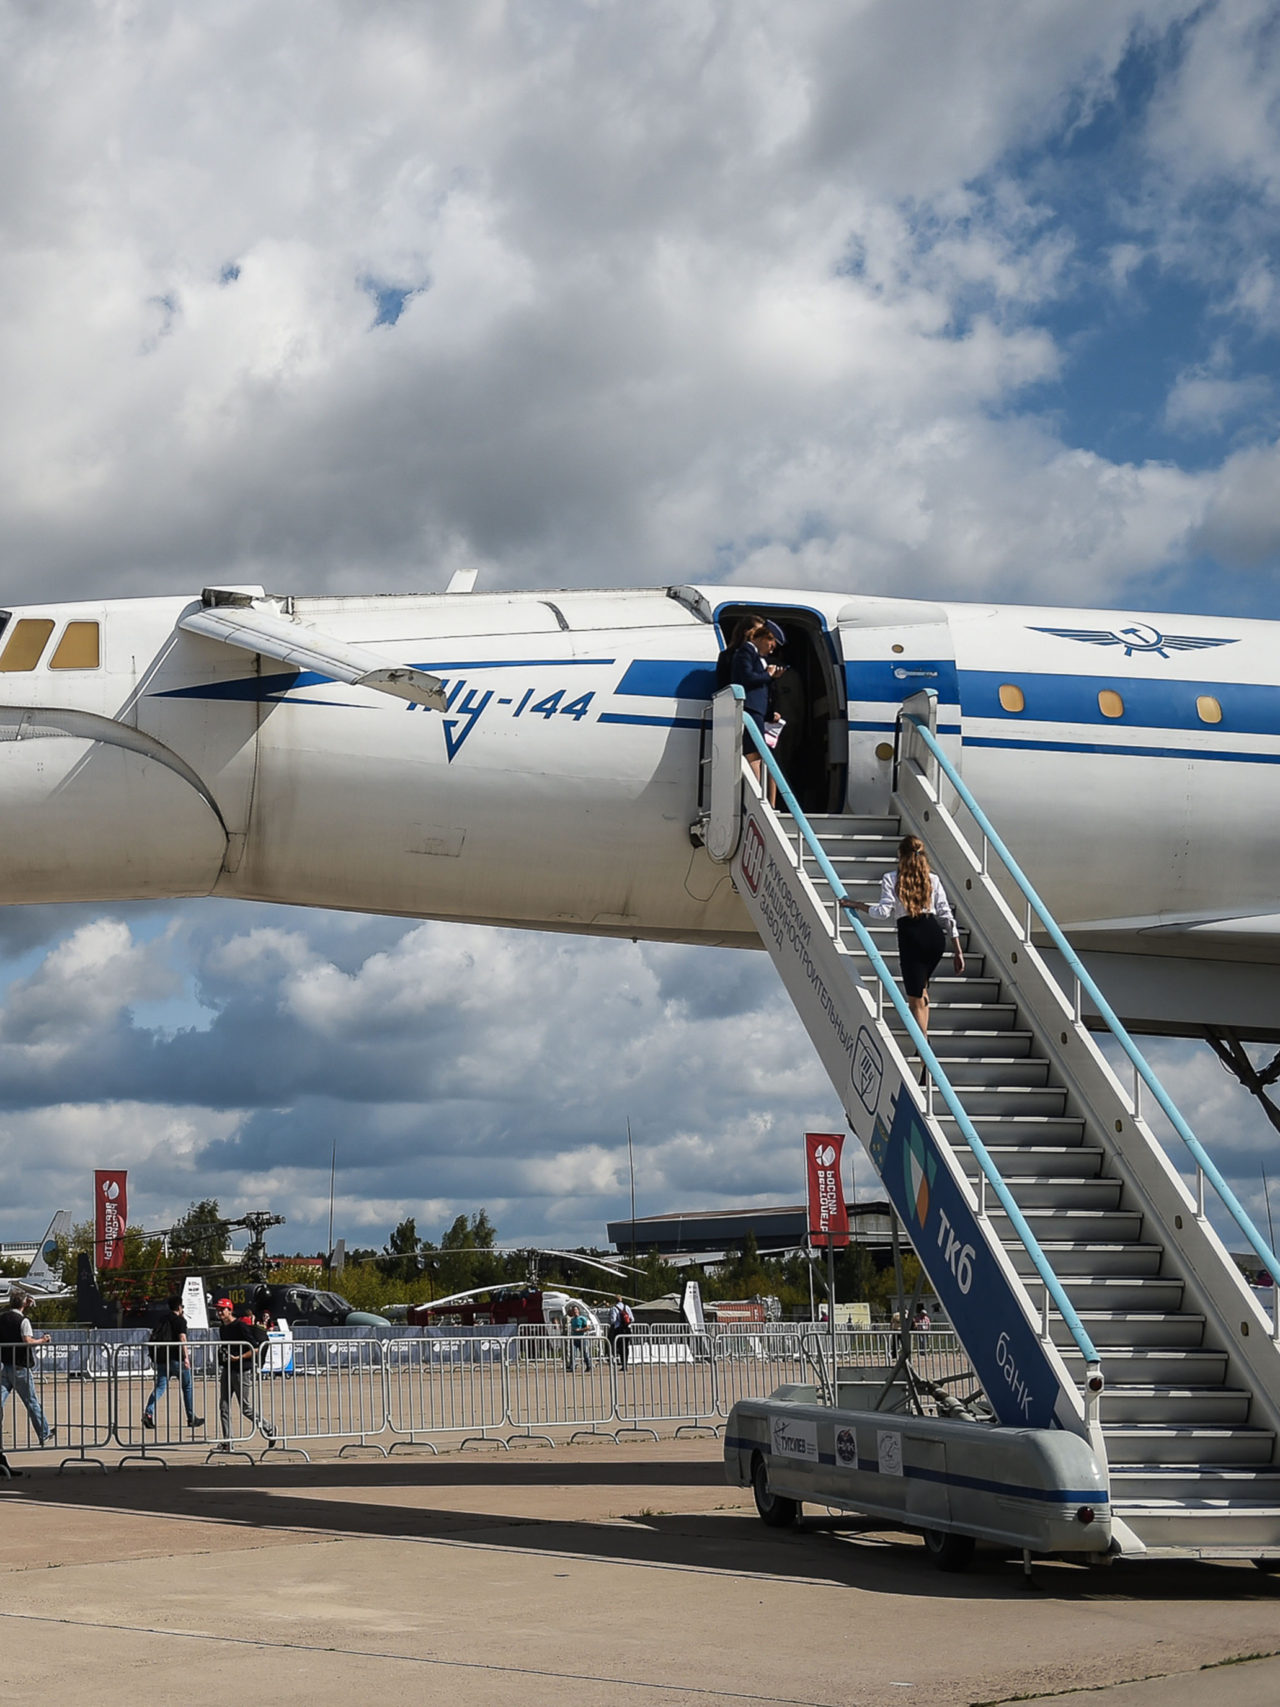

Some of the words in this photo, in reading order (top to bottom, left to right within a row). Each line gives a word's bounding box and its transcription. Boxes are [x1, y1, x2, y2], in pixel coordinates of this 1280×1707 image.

[759, 894, 783, 951] ЗАВОД
[767, 855, 812, 947] ЖУКОВСКИЙ
[763, 875, 854, 1058] МАШИНОСТРОИТЕЛЬНЫЙ
[229, 1288, 246, 1304] 103
[995, 1331, 1033, 1420] банк
